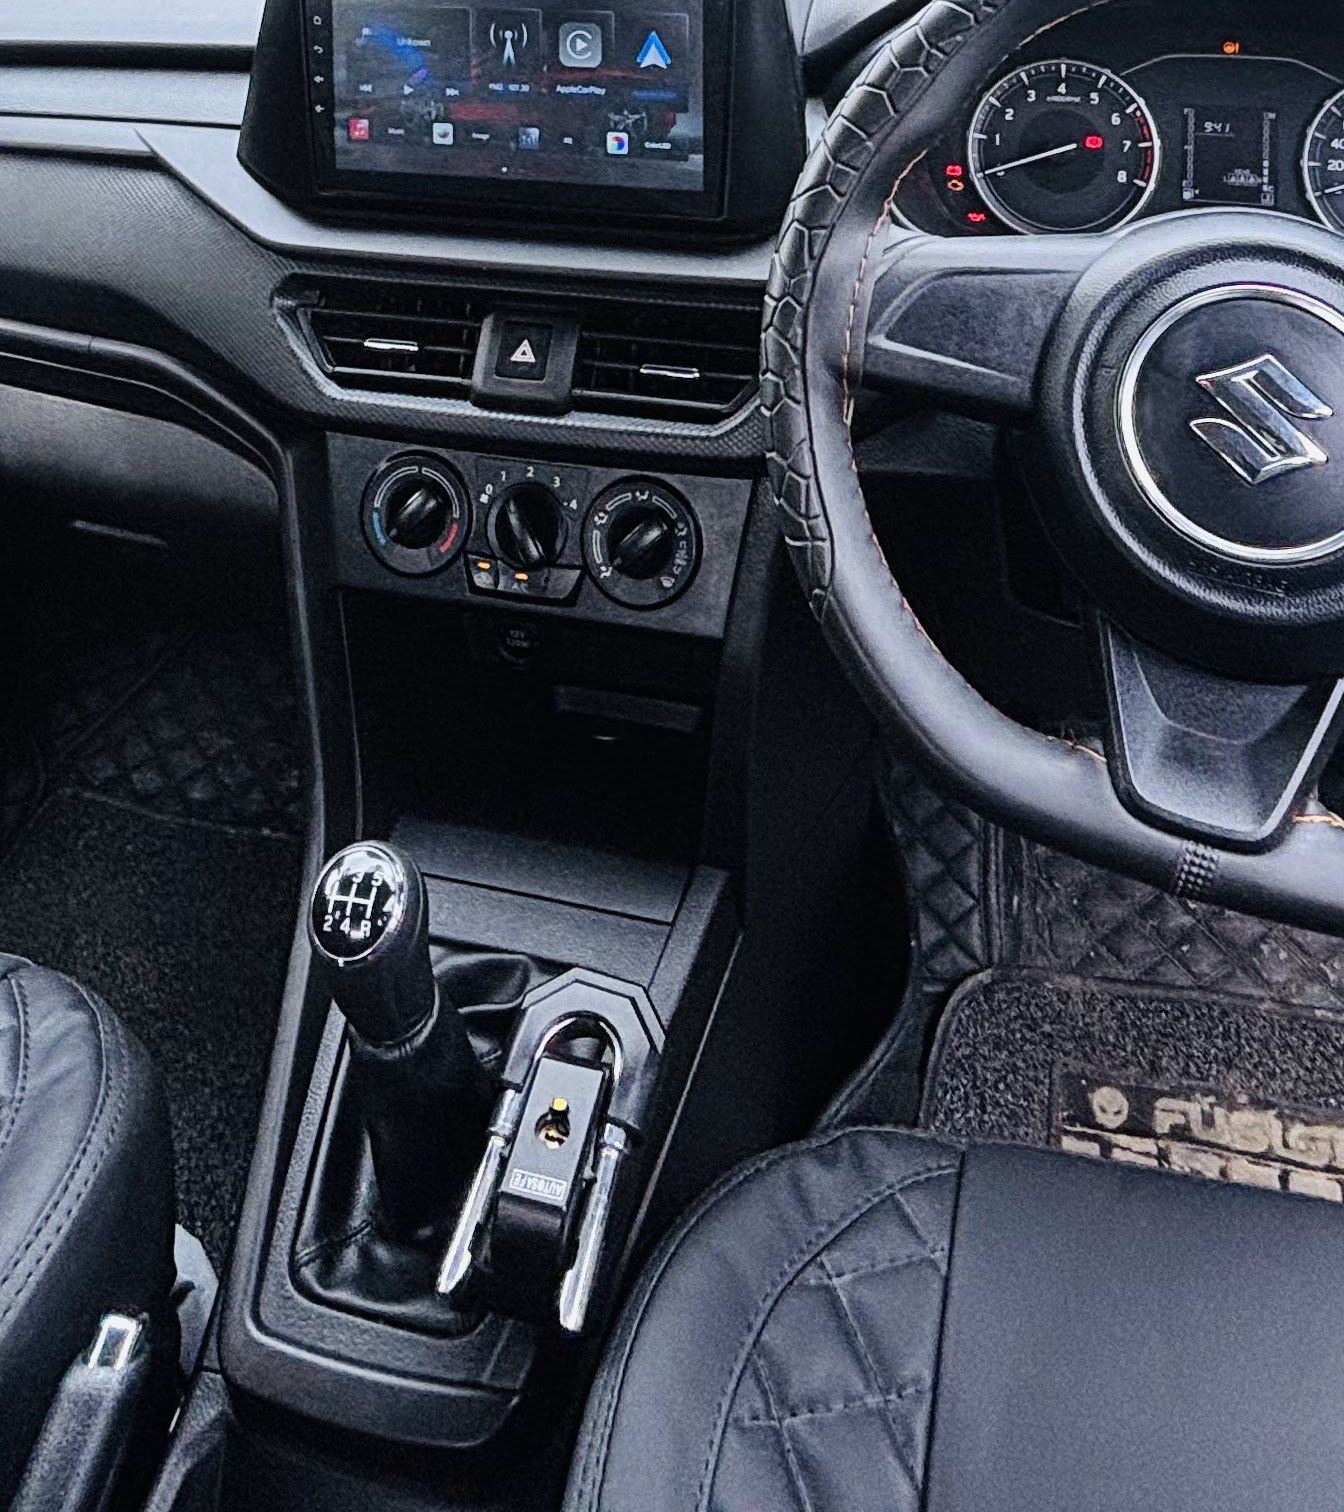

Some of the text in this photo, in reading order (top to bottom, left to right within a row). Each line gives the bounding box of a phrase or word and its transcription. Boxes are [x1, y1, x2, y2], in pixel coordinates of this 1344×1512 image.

[1056, 82, 1067, 95] 4
[1026, 90, 1036, 102] 3
[1089, 92, 1099, 105] 5
[1004, 108, 1014, 121] 2
[1110, 112, 1121, 125] 6
[994, 133, 1001, 146] 1
[1122, 140, 1131, 153] 7
[1327, 159, 1344, 172] 20
[1117, 170, 1127, 183] 8
[500, 471, 507, 481] 1
[526, 465, 535, 478] 2
[553, 475, 561, 488] 3
[485, 483, 494, 495] 0
[569, 499, 578, 510] 4
[371, 870, 385, 887] 5
[322, 914, 372, 937] 2 4 R
[513, 1172, 564, 1197] AUTOSAFE
